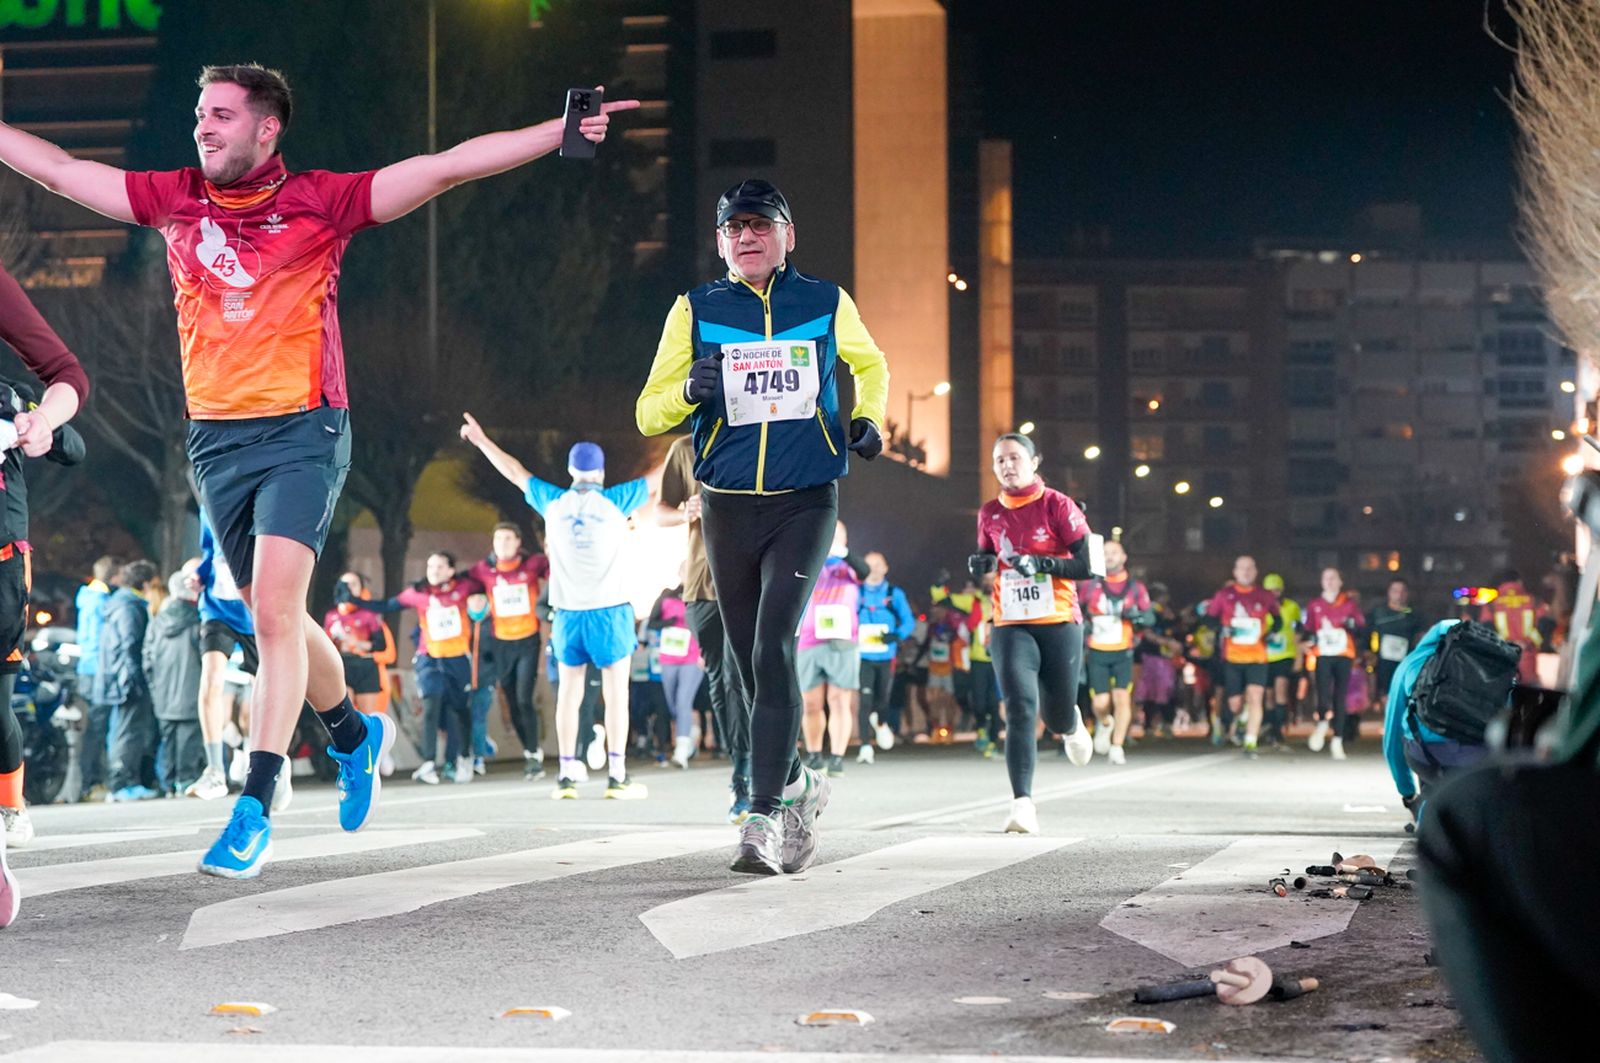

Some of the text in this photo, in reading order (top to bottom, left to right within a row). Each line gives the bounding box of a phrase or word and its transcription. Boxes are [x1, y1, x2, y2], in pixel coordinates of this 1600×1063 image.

[212, 253, 236, 277] 43
[743, 351, 770, 359] NOCHE
[771, 350, 782, 358] DE
[733, 361, 751, 371] SAN
[753, 359, 783, 370] ANTÓN
[744, 369, 800, 395] 4749
